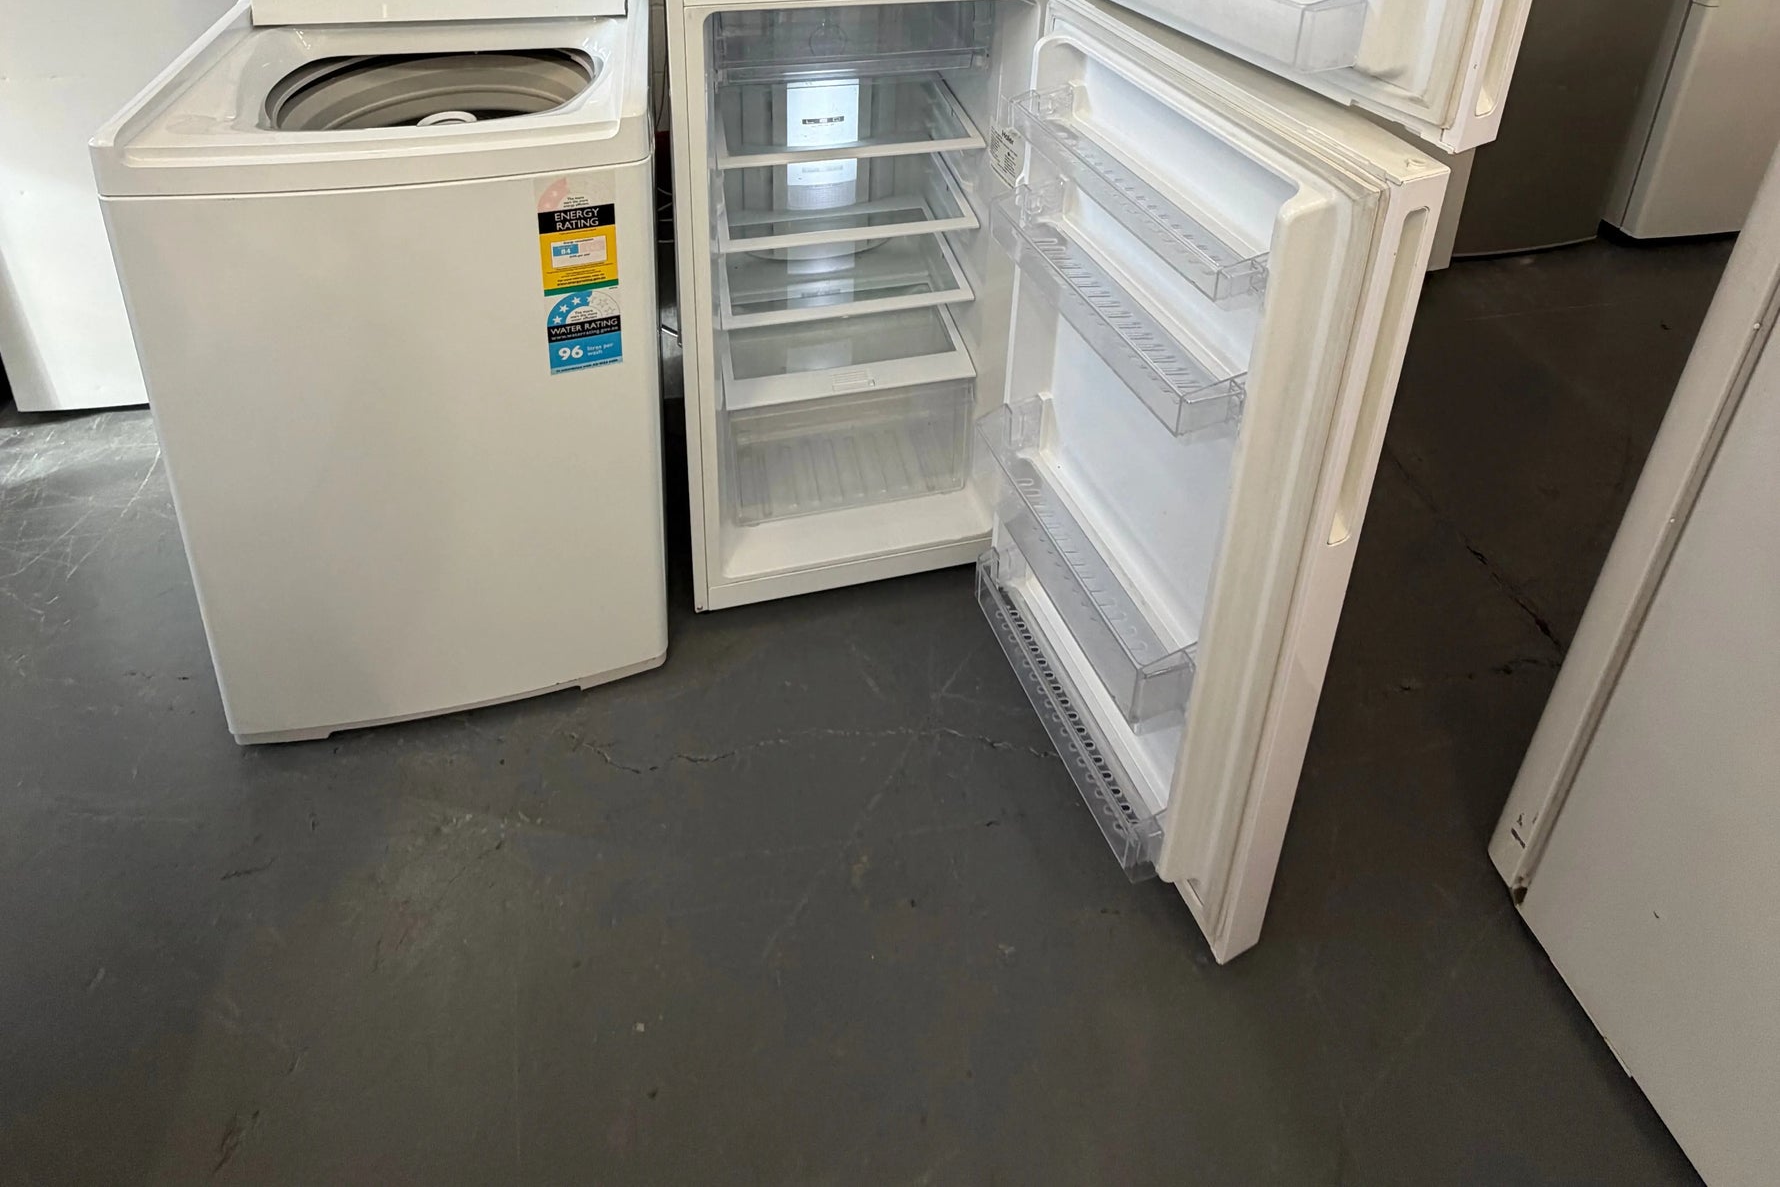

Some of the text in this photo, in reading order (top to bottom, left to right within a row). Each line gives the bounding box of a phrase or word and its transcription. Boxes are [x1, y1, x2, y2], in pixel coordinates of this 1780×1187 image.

[554, 207, 599, 221] ENERGY
[556, 217, 599, 231] RATING
[550, 318, 618, 335] WATER RATING
[558, 345, 583, 360] 96
